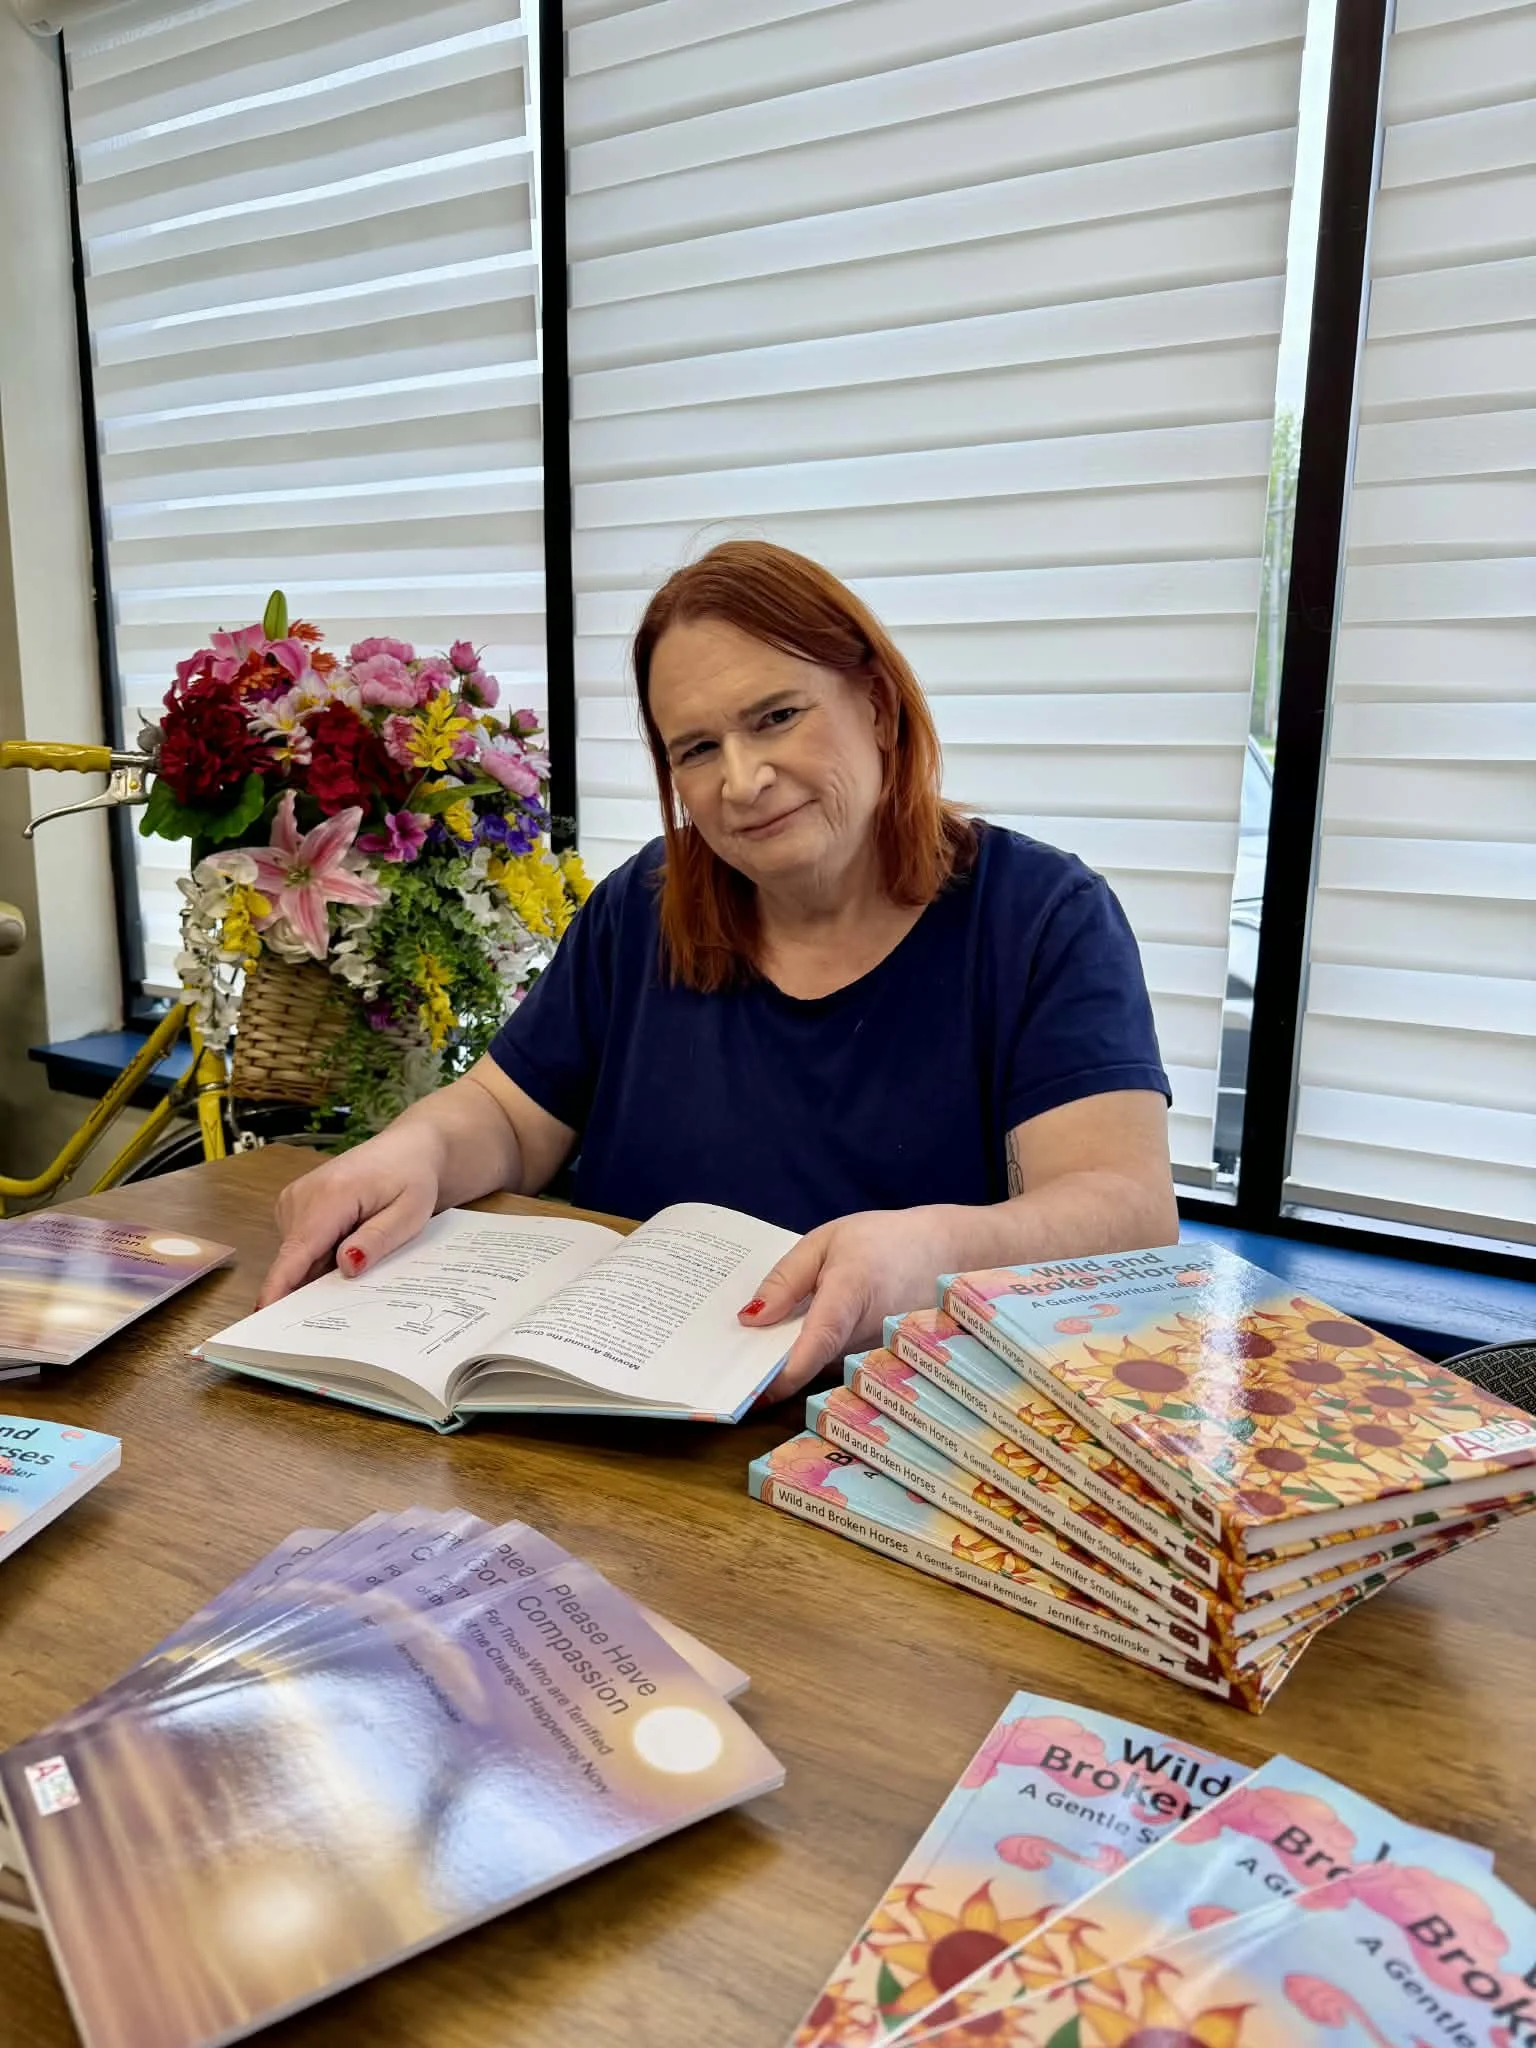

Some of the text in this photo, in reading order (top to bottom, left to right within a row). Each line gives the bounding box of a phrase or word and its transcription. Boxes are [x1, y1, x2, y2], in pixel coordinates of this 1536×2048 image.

[1009, 1275, 1118, 1296] Broken
[1031, 1252, 1164, 1278] Wild and
[1031, 1300, 1045, 1309] A
[1046, 1293, 1096, 1305] Gentle
[1100, 1283, 1166, 1299] Spiritual
[546, 1333, 562, 1341] the
[564, 1337, 602, 1354] Around
[603, 1351, 641, 1371] Moving
[979, 1323, 1001, 1348] Broken
[902, 1343, 988, 1413] Wild and Broken Horses
[864, 1381, 958, 1452] Wild and Broken Horses
[992, 1412, 998, 1420] A
[830, 1422, 936, 1494] Wild and Broken Horses
[963, 1450, 968, 1459] A
[970, 1455, 991, 1474] Gentle
[1022, 1489, 1056, 1517] Reminder
[778, 1487, 909, 1553] Wild and Broken Horses
[941, 1491, 1043, 1557] A Gentle Spiritual Reminder
[1083, 1477, 1159, 1537] Jennifer Smolinske
[1061, 1515, 1143, 1577] Jennifer Smolinske
[916, 1551, 1038, 1607] A Gentle Spiritual Reminder
[1051, 1557, 1140, 1615] Jennifer Smolinske
[517, 1595, 630, 1715] Compassion
[547, 1583, 657, 1697] Please Have
[1047, 1605, 1150, 1657] Jennifer Smolinske
[470, 1629, 490, 1648] the
[486, 1647, 530, 1697] Changes
[525, 1696, 585, 1764] Happening
[581, 1762, 610, 1794] Now
[485, 1609, 615, 1755] For Those Who are Terrified
[1123, 1737, 1233, 1797] Wild
[1018, 1782, 1037, 1799] A
[1045, 1791, 1131, 1835] Gentle
[1235, 1857, 1258, 1877] A
[1355, 1936, 1384, 1957] A
[1384, 1958, 1477, 2048] Gentle
